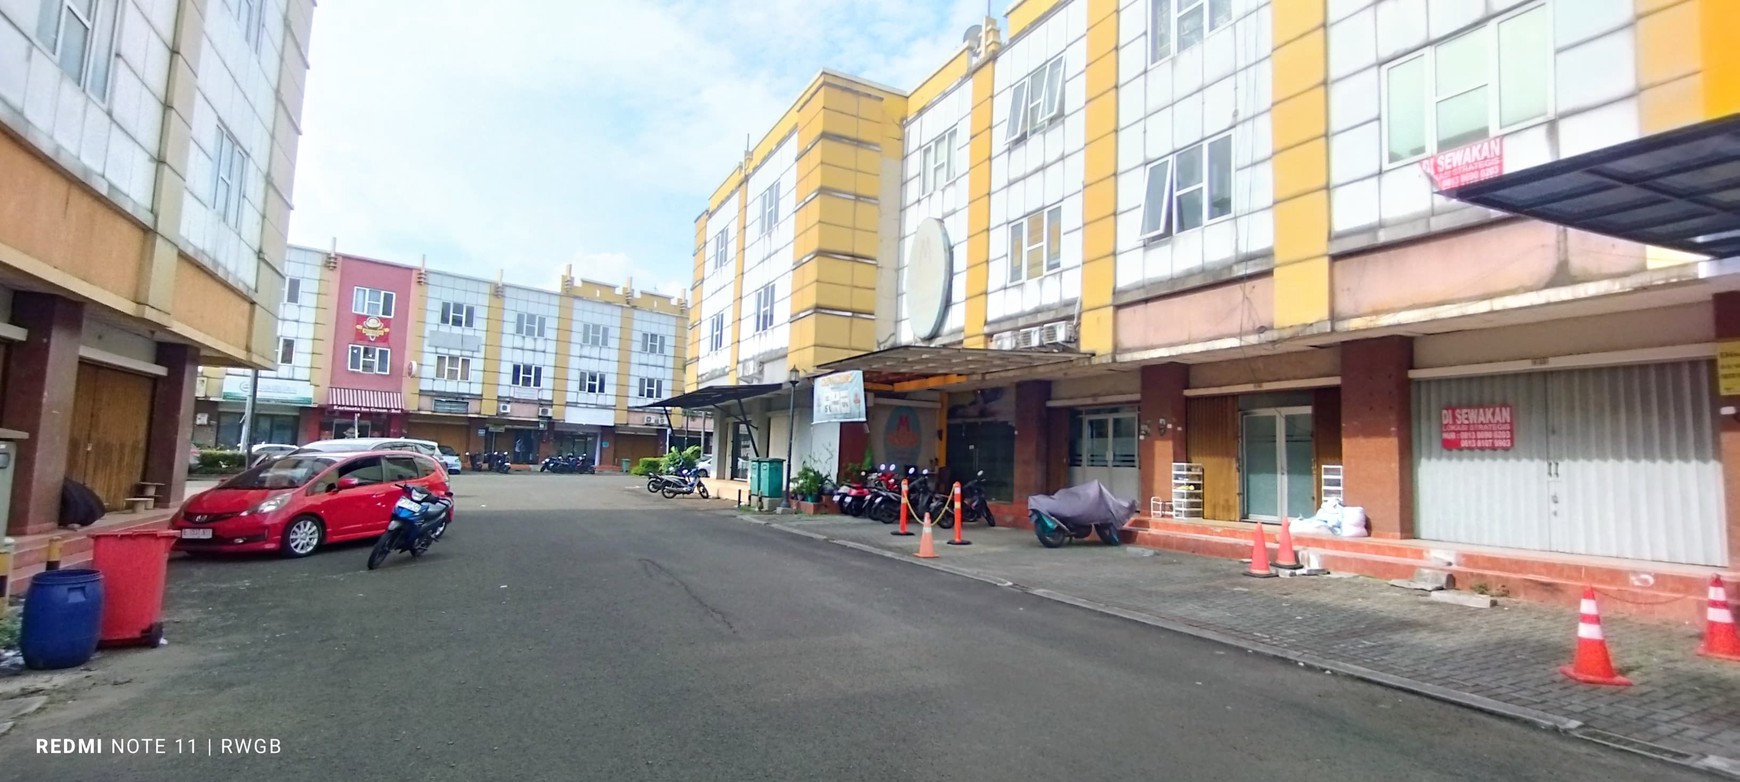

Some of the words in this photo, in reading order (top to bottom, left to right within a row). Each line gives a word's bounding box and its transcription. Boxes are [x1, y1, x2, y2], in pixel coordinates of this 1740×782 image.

[1437, 138, 1501, 173] SEWAKAN
[1441, 409, 1453, 424] DI
[1455, 407, 1511, 424] SEWAKAN
[1442, 424, 1469, 432] LOKASI
[1469, 423, 1511, 431] STRATEGIS
